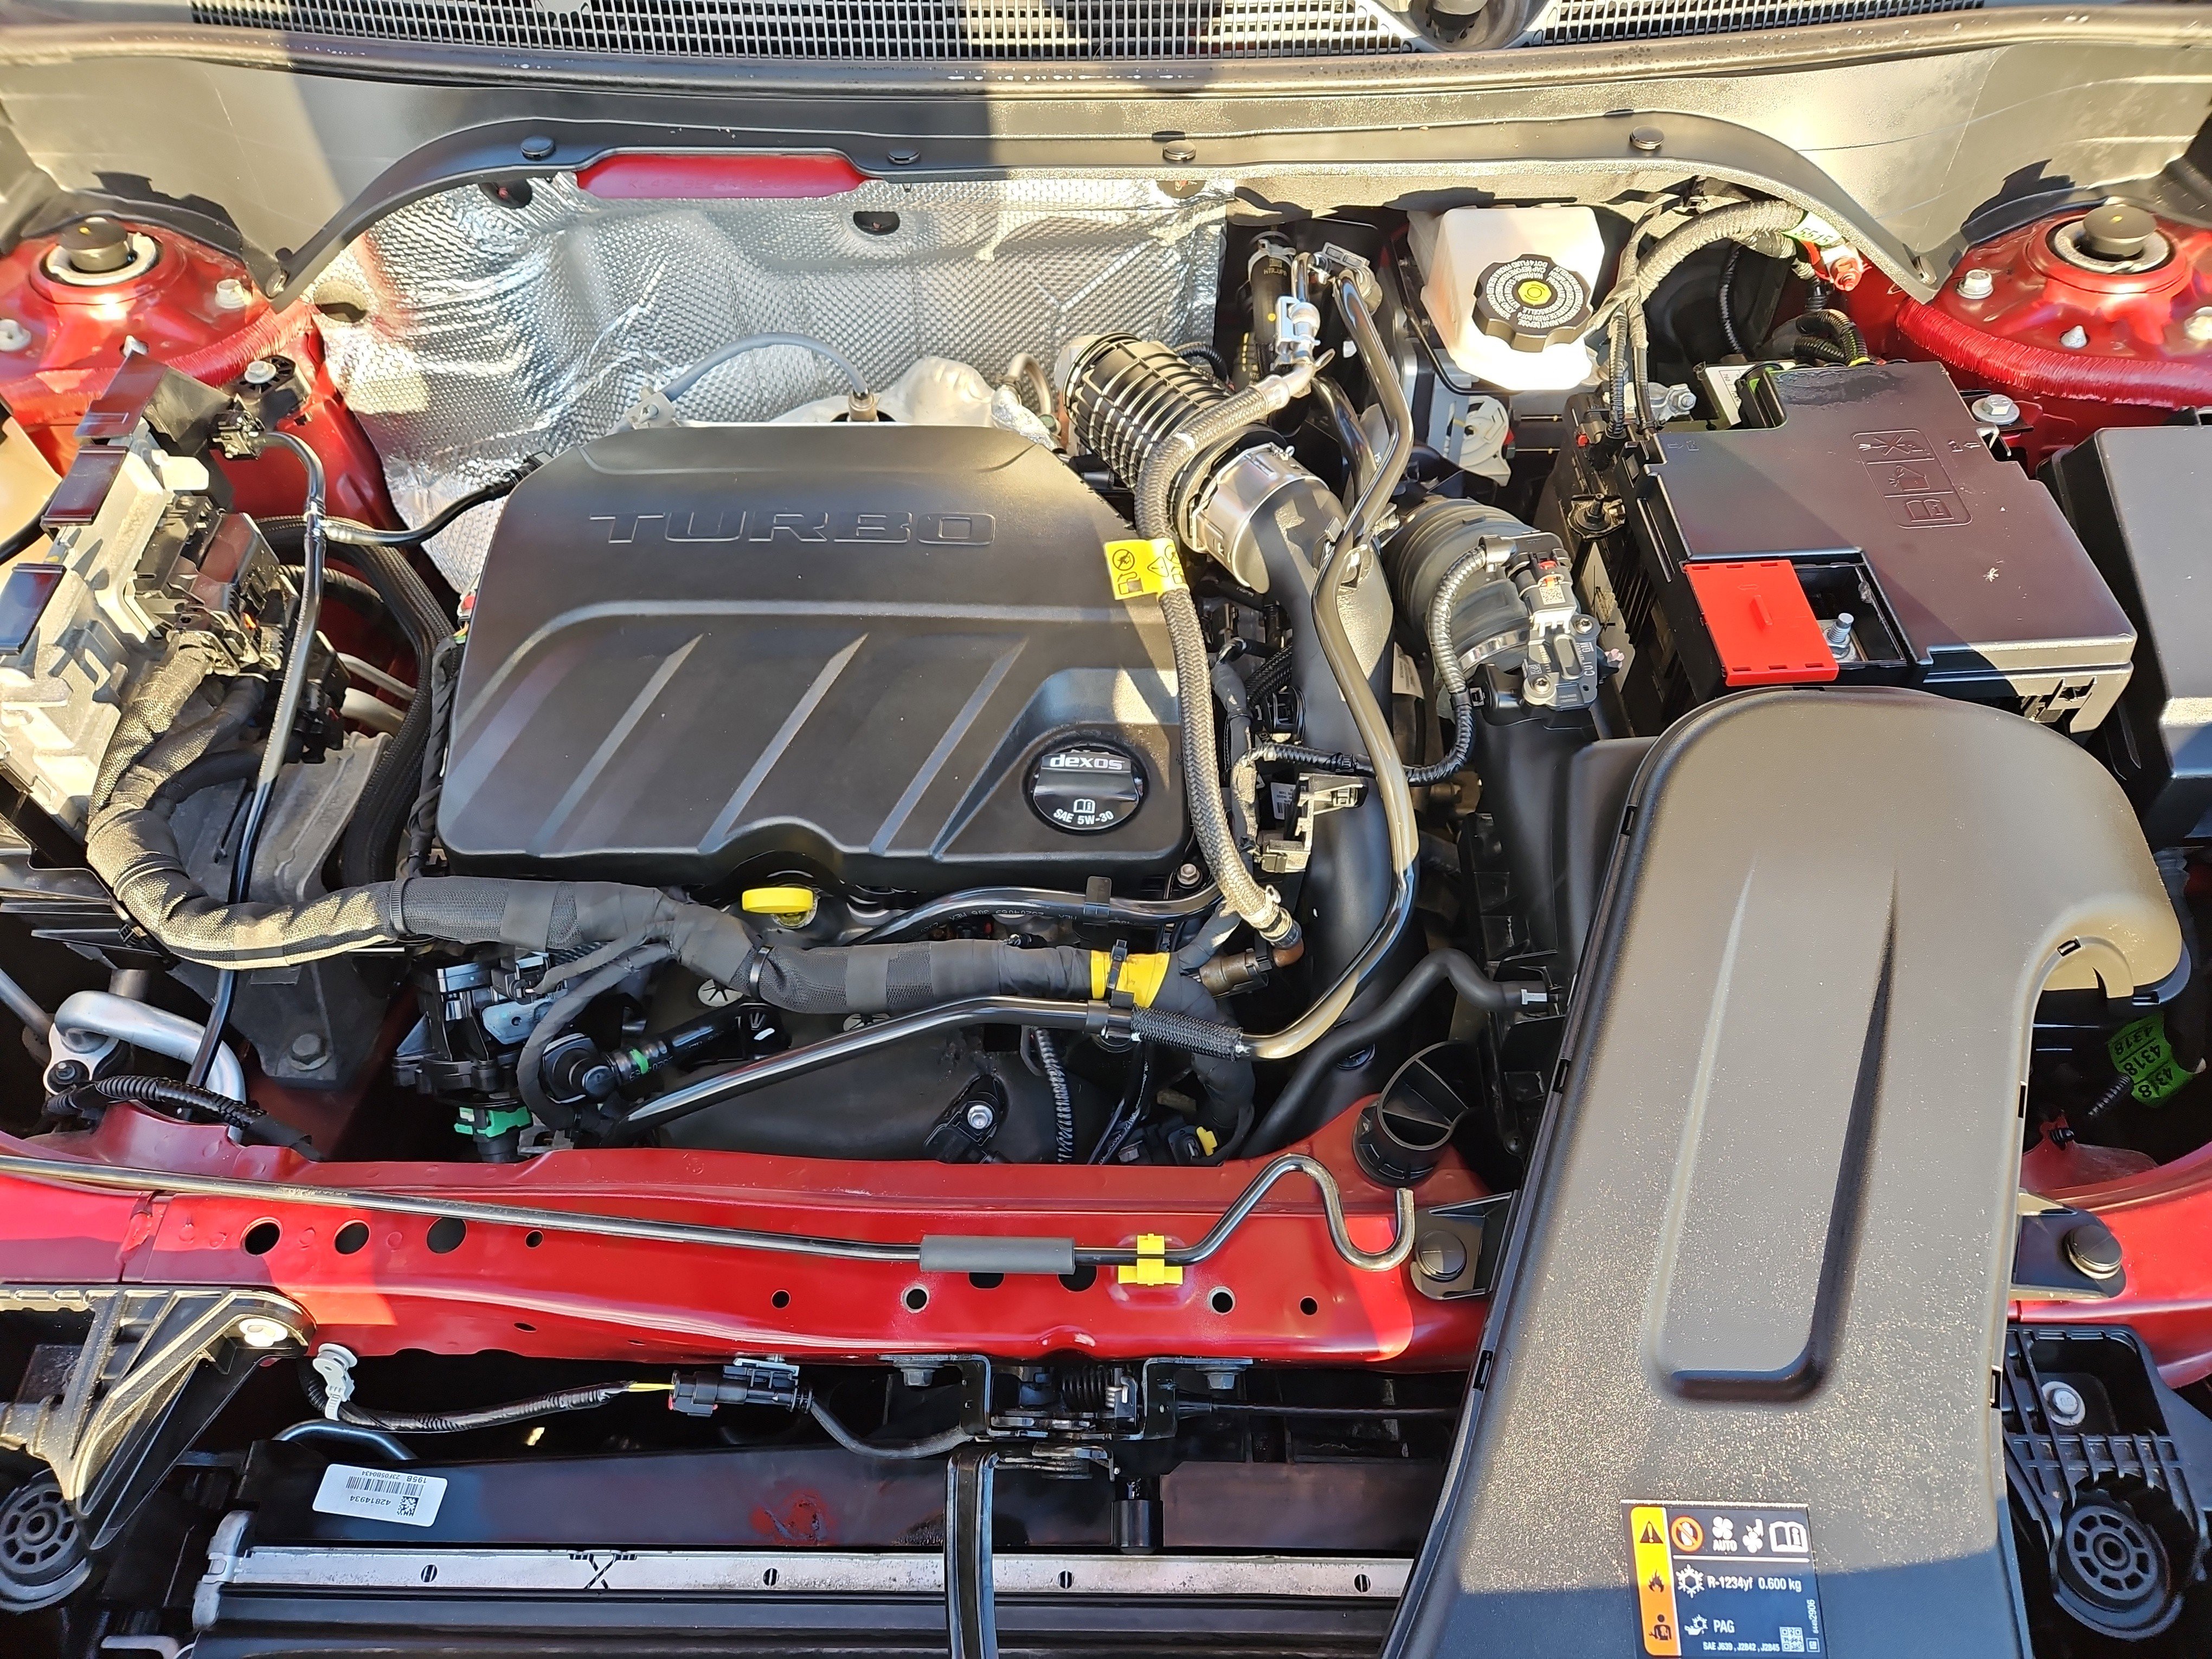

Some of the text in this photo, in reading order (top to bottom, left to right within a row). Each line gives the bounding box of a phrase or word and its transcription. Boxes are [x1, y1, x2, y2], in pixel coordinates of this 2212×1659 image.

[1794, 227, 1833, 243] 5515
[1494, 263, 1513, 275] FROM
[1507, 265, 1532, 275] BEFORE
[1510, 260, 1529, 268] FLUID
[1499, 301, 1516, 314] ONLY
[1504, 294, 1521, 309] FILLER
[590, 511, 995, 544] TURBO
[1580, 642, 1591, 653] GM
[1050, 754, 1122, 770] dexos
[1053, 809, 1114, 825] SAE 5W-30
[2123, 1044, 2160, 1076] 4318
[362, 1471, 427, 1484] 195B 23F05B0434
[350, 1495, 391, 1506] 42814934
[1713, 1540, 1737, 1551] AUTO
[1707, 1576, 1802, 1592] R-1234yf 0.600 kg
[1713, 1619, 1735, 1633] PAG
[1703, 1642, 1716, 1650] SAE
